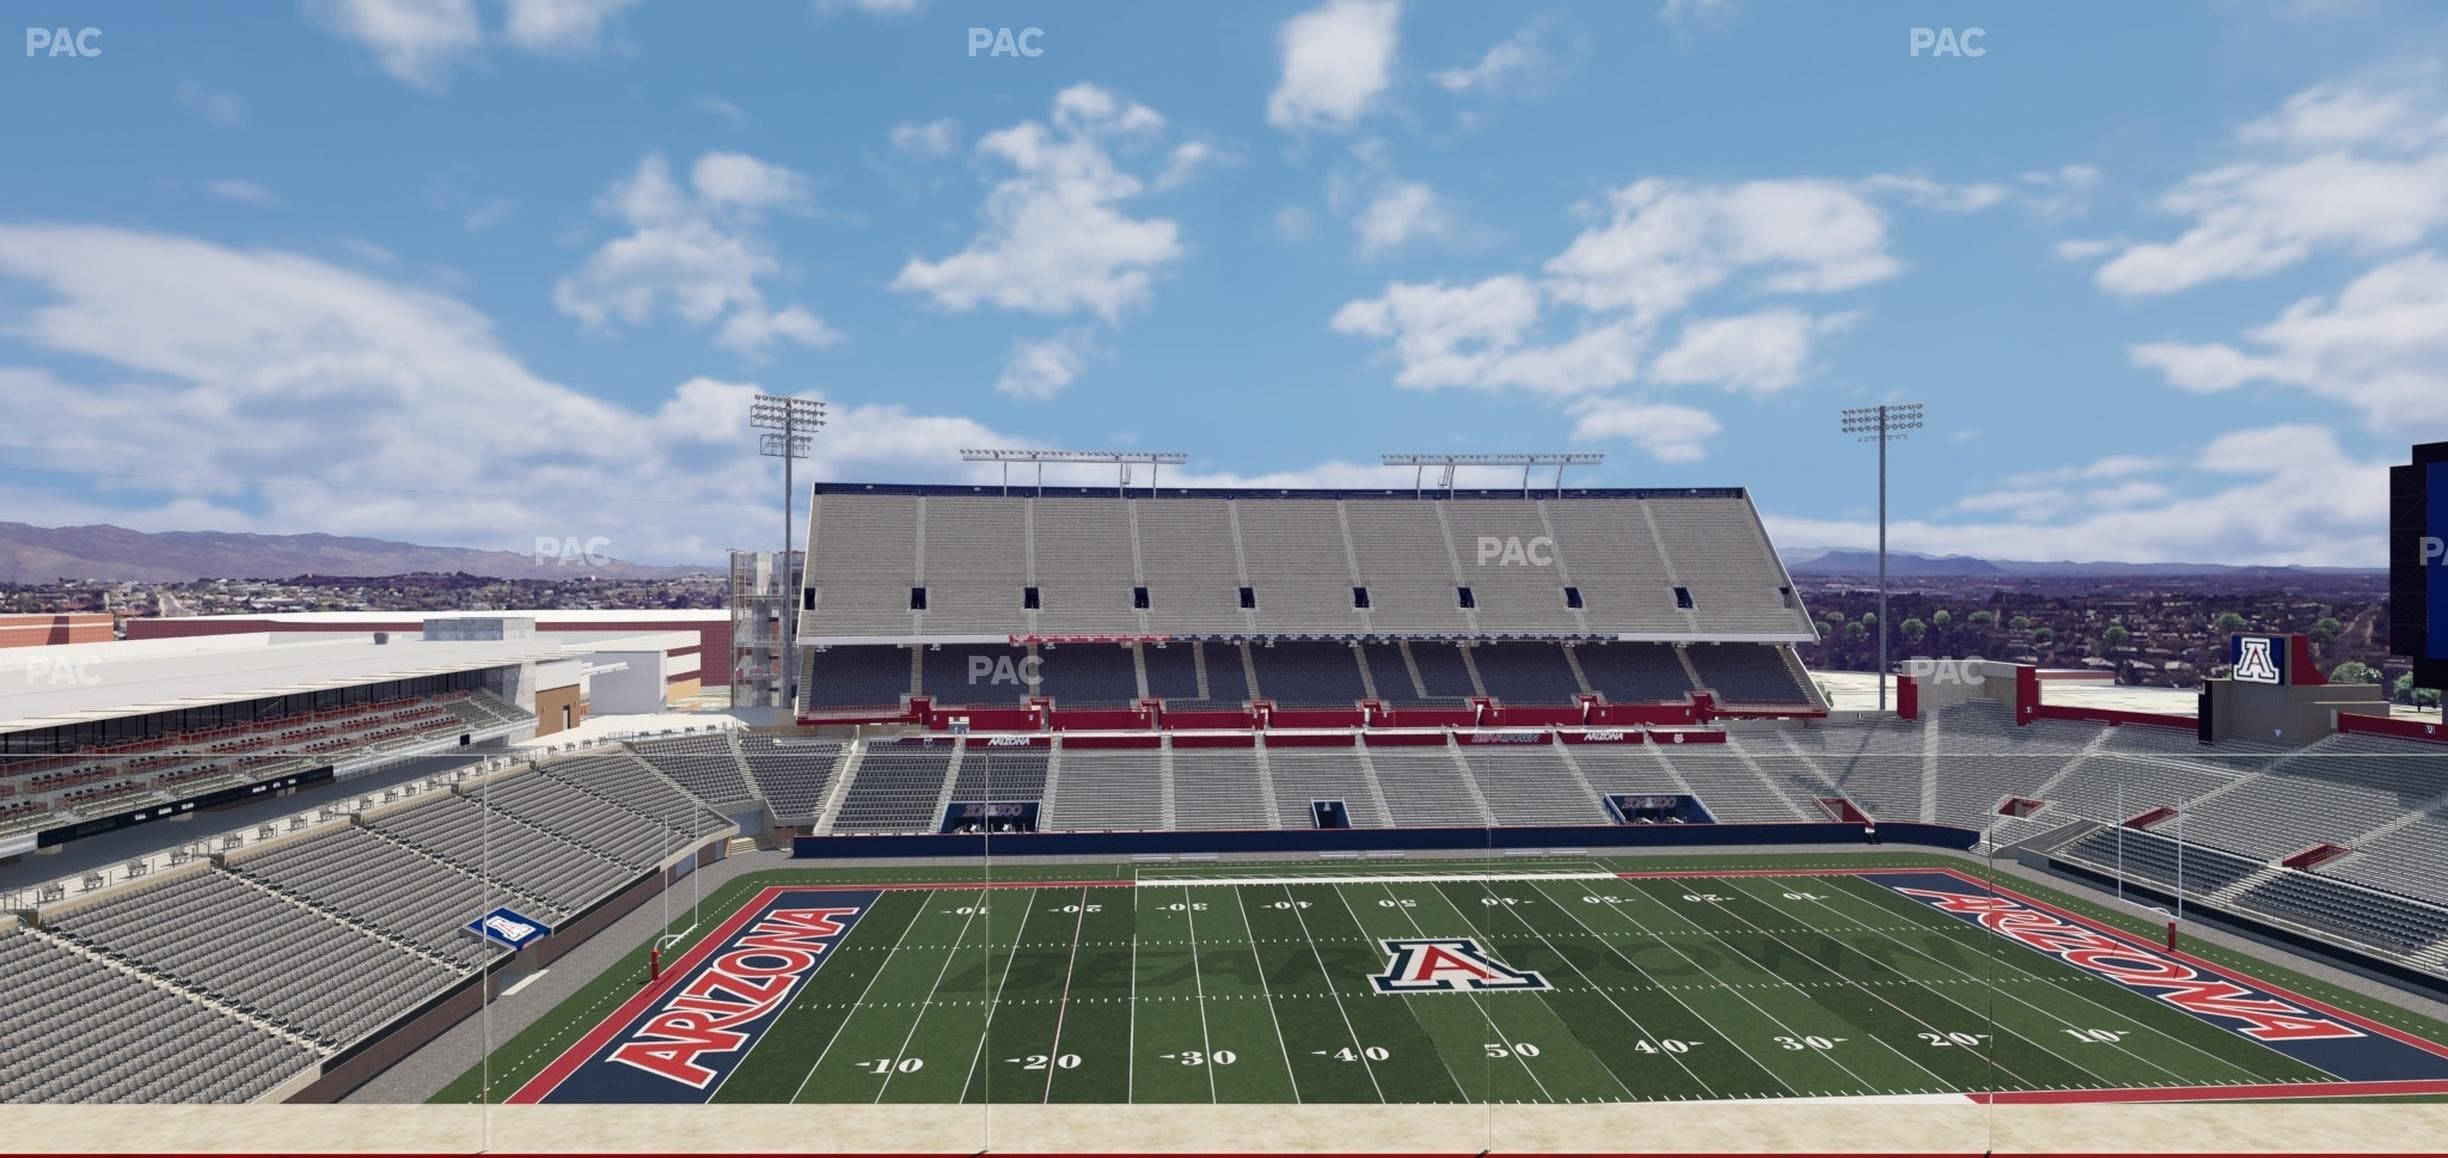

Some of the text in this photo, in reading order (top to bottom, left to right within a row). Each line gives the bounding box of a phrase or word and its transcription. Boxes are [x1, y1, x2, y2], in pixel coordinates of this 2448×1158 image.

[2233, 637, 2280, 685] A
[988, 736, 1030, 746] ARIZONA
[1582, 731, 1625, 741] ARIZONA
[1366, 937, 1555, 994] A
[1894, 887, 2369, 1041] ARIZONA
[604, 907, 861, 1090] ARIZONA
[1773, 1035, 1834, 1050] 30
[1917, 1031, 1979, 1047] 20
[2059, 1028, 2121, 1043] 10
[1333, 1046, 1390, 1062] 40
[1483, 1042, 1540, 1058] 50
[1634, 1038, 1689, 1054] 40
[869, 1057, 924, 1074] 10
[1023, 1053, 1082, 1070] 20
[1180, 1049, 1237, 1066] 30
